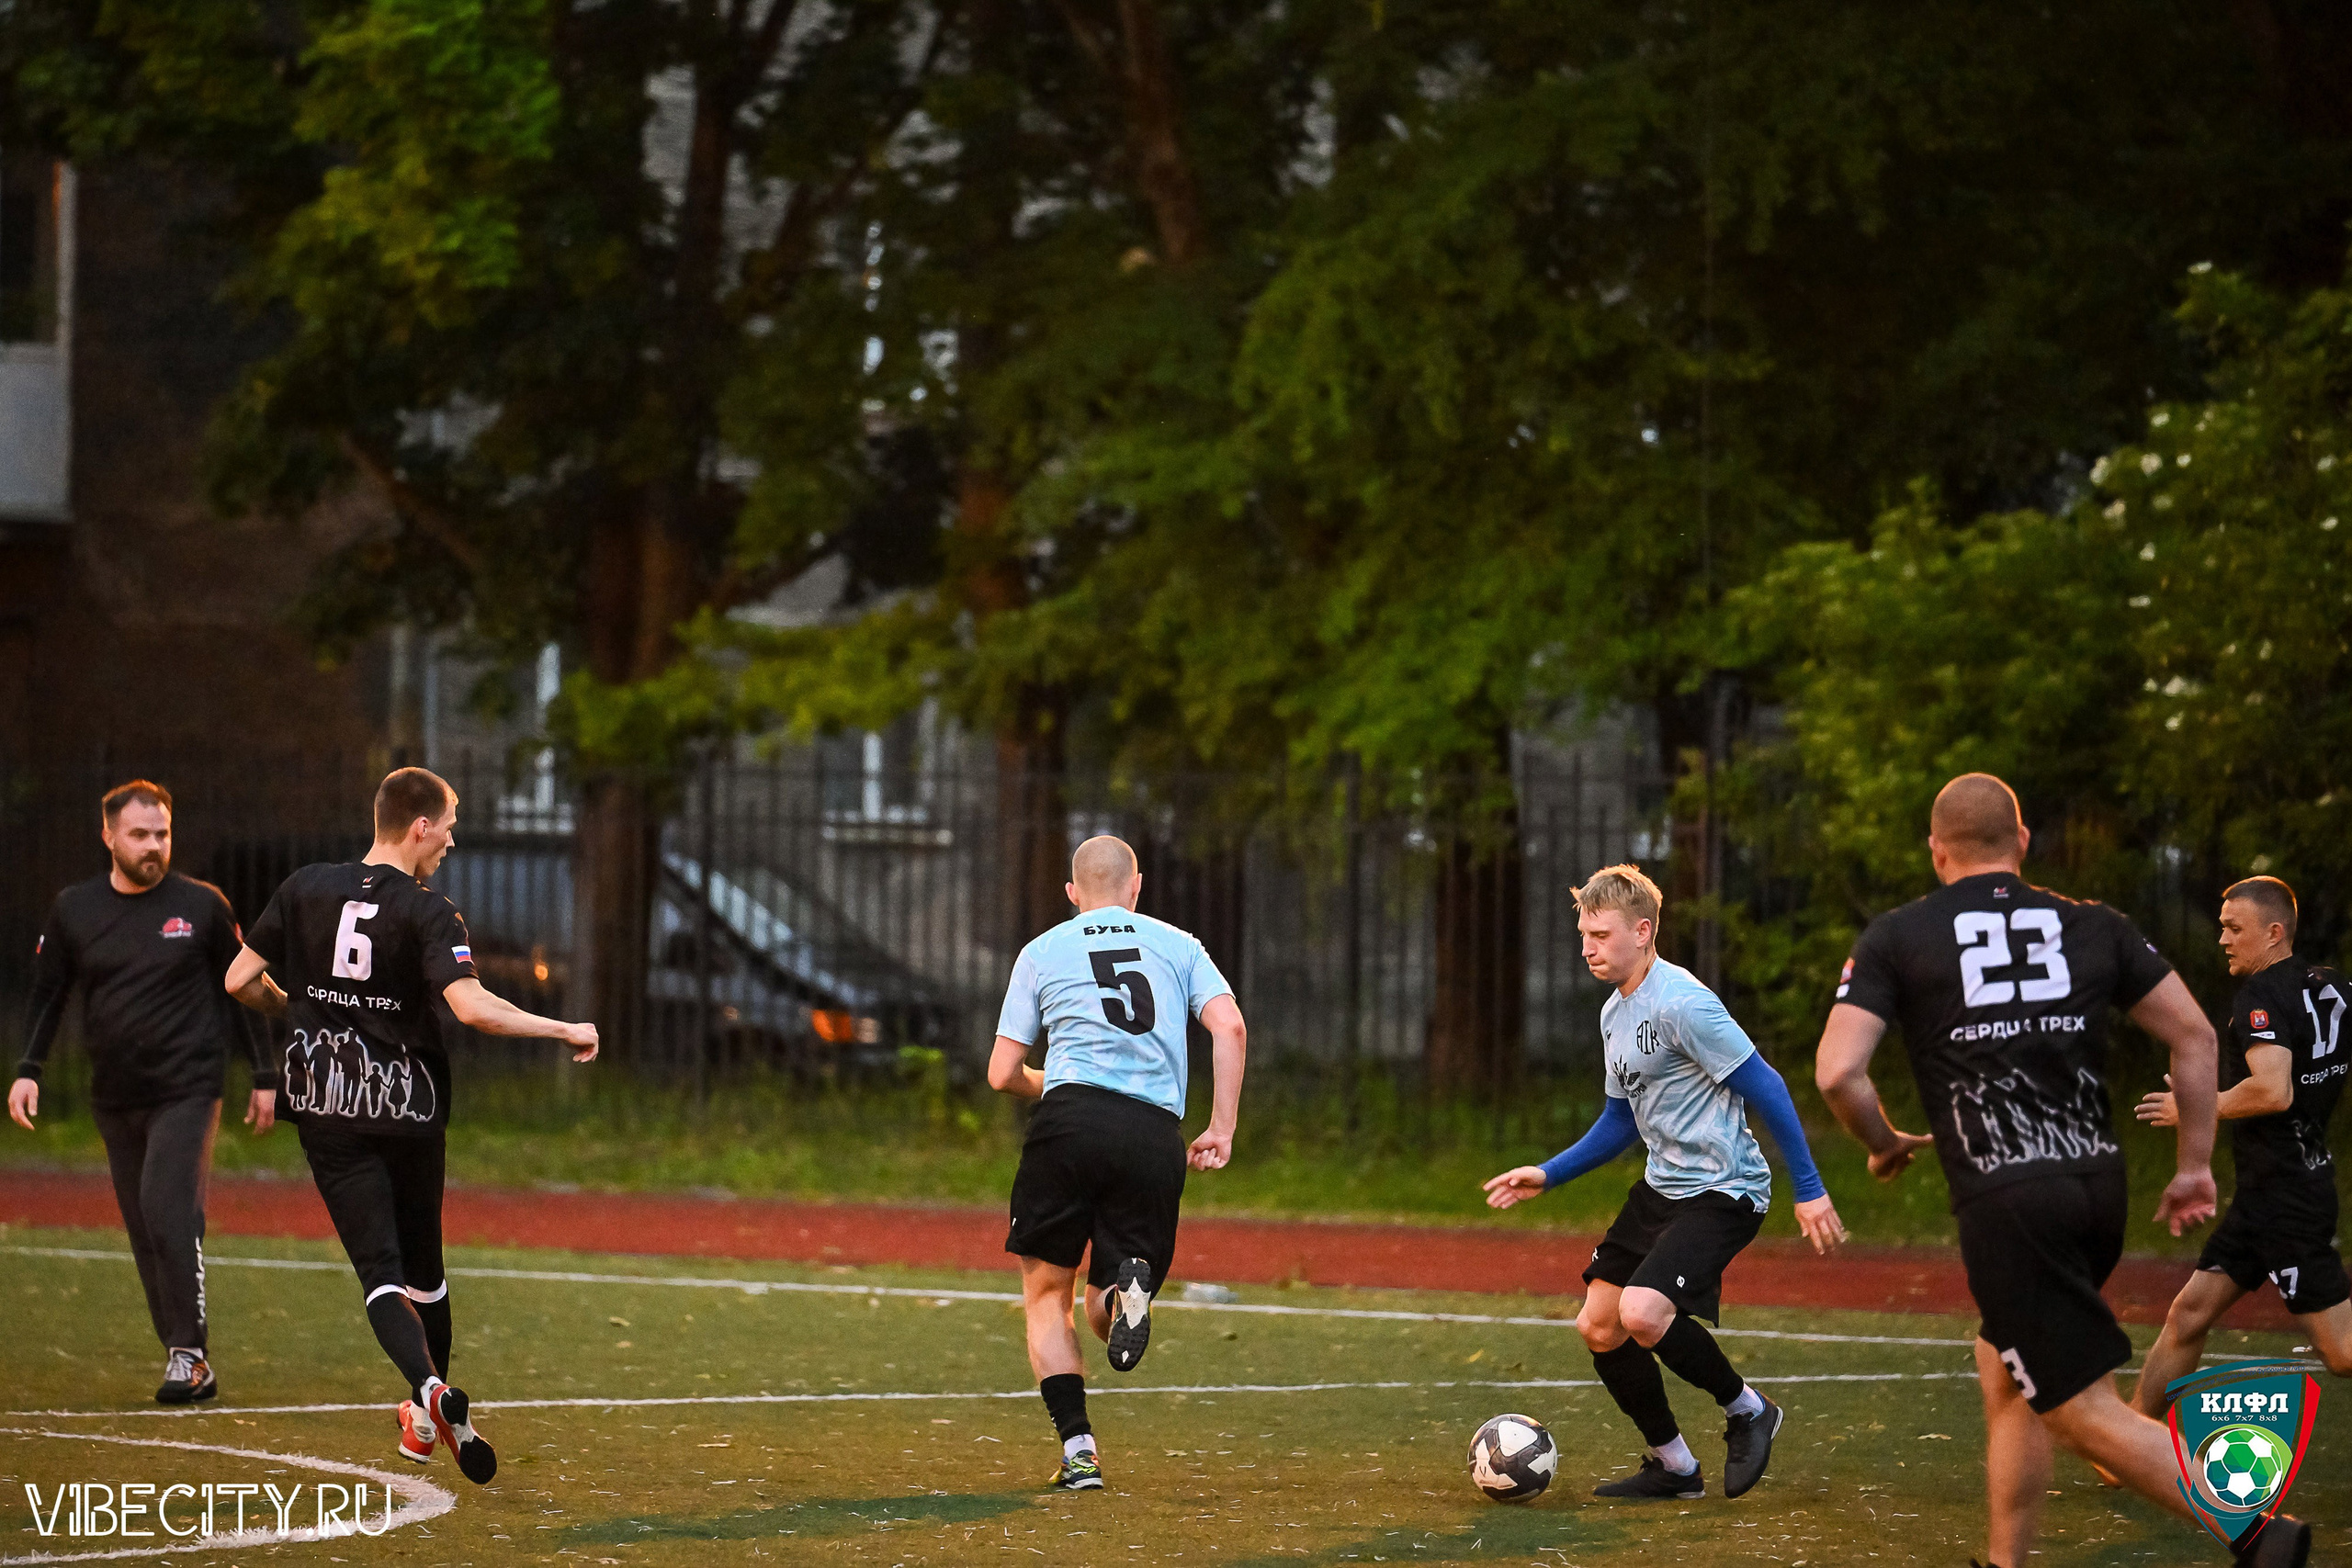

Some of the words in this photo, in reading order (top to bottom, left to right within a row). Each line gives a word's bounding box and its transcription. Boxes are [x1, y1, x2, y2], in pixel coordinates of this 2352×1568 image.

[332, 900, 379, 981] 6
[1083, 924, 1136, 936] БУБА
[1953, 907, 2071, 1008] 23
[1088, 947, 1155, 1035] 5
[2039, 1014, 2086, 1032] ТРЕХ
[2302, 984, 2347, 1059] 17
